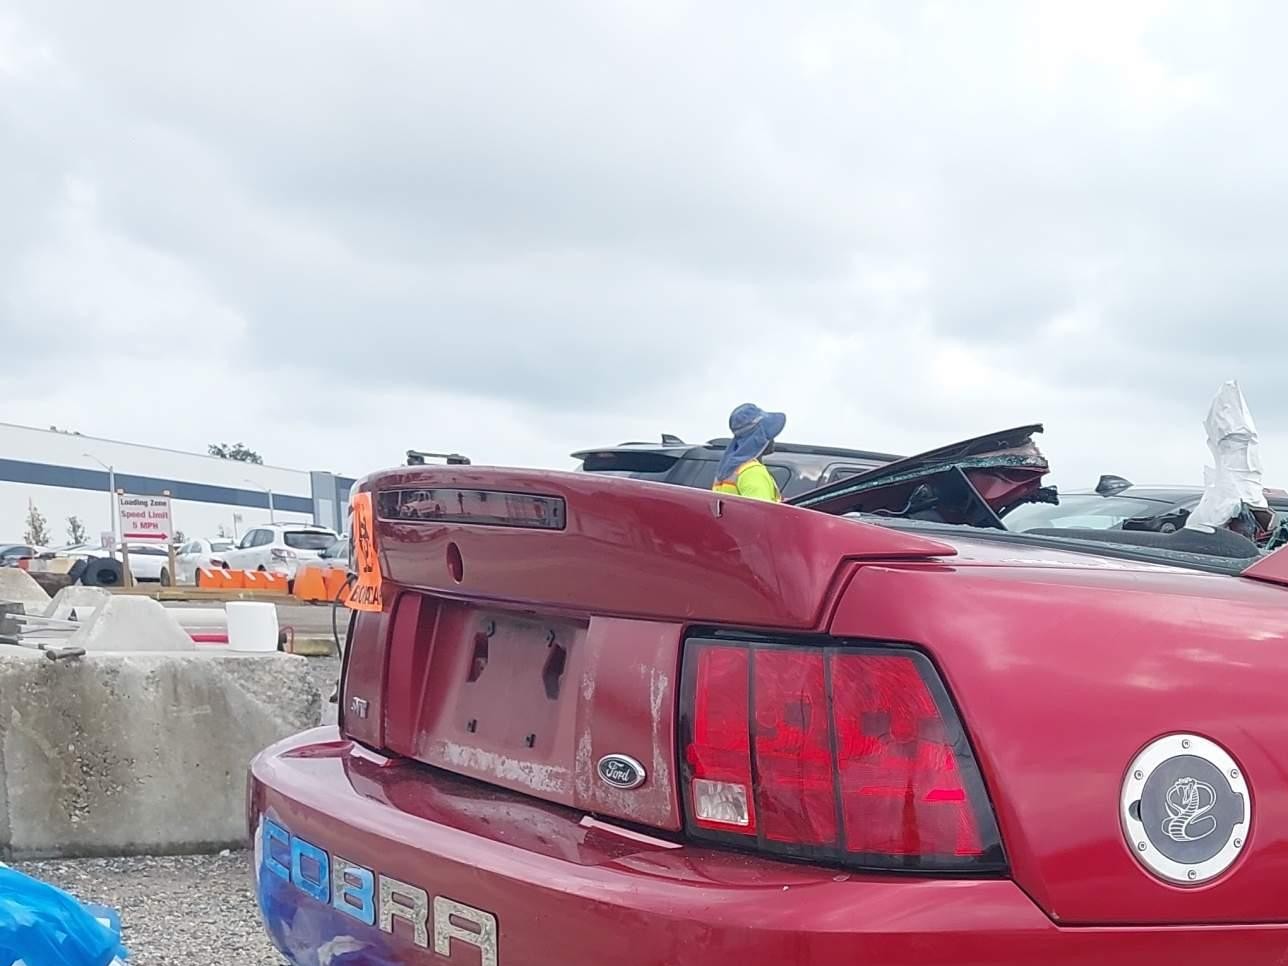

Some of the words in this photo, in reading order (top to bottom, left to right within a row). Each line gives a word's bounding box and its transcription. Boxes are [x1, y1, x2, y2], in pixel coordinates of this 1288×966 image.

[120, 498, 149, 507] Loading
[120, 510, 146, 519] Speed
[148, 511, 169, 519] Limit
[132, 521, 138, 529] 5
[605, 760, 631, 782] Ford
